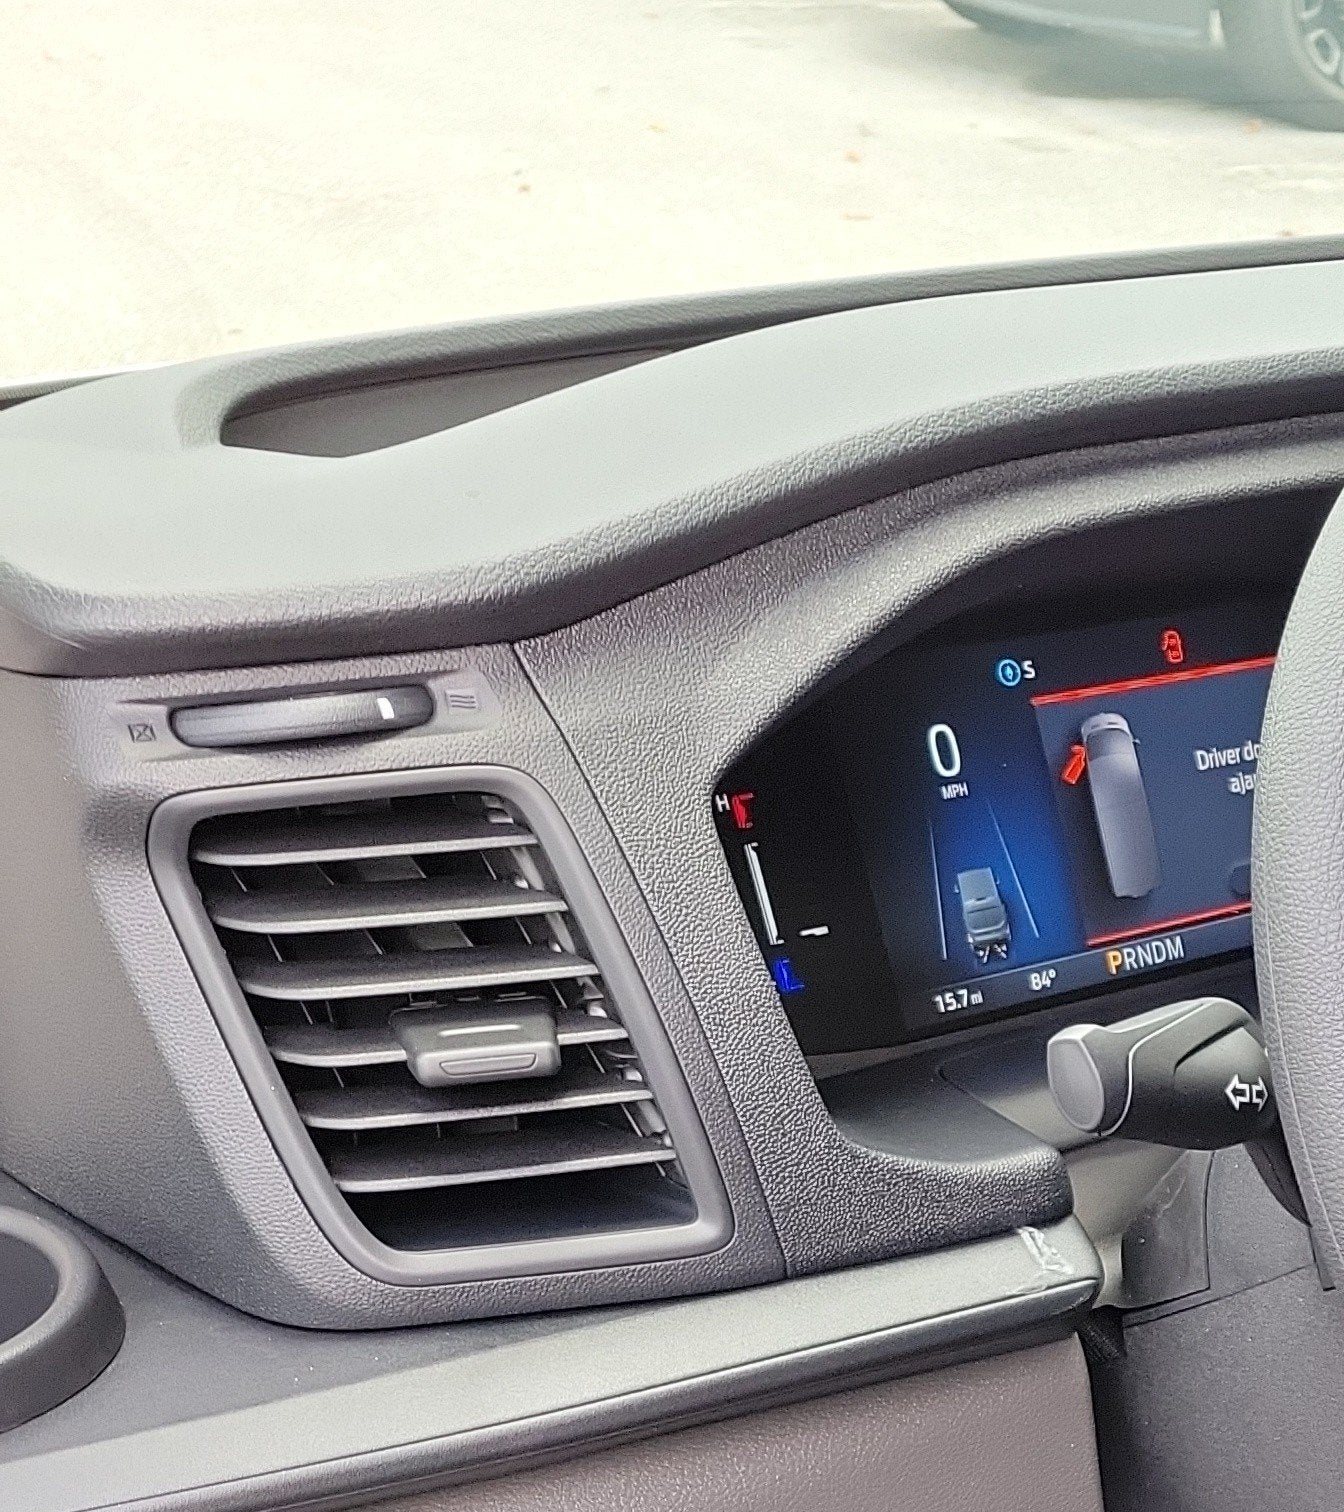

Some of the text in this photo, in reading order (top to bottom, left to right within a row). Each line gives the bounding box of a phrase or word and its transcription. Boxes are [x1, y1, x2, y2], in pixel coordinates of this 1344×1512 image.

[1022, 659, 1036, 679] S
[928, 723, 962, 778] 0
[1194, 746, 1241, 771] Driver
[940, 782, 969, 800] MPH
[1106, 935, 1185, 976] PRNDM
[933, 988, 969, 1014] 15.7
